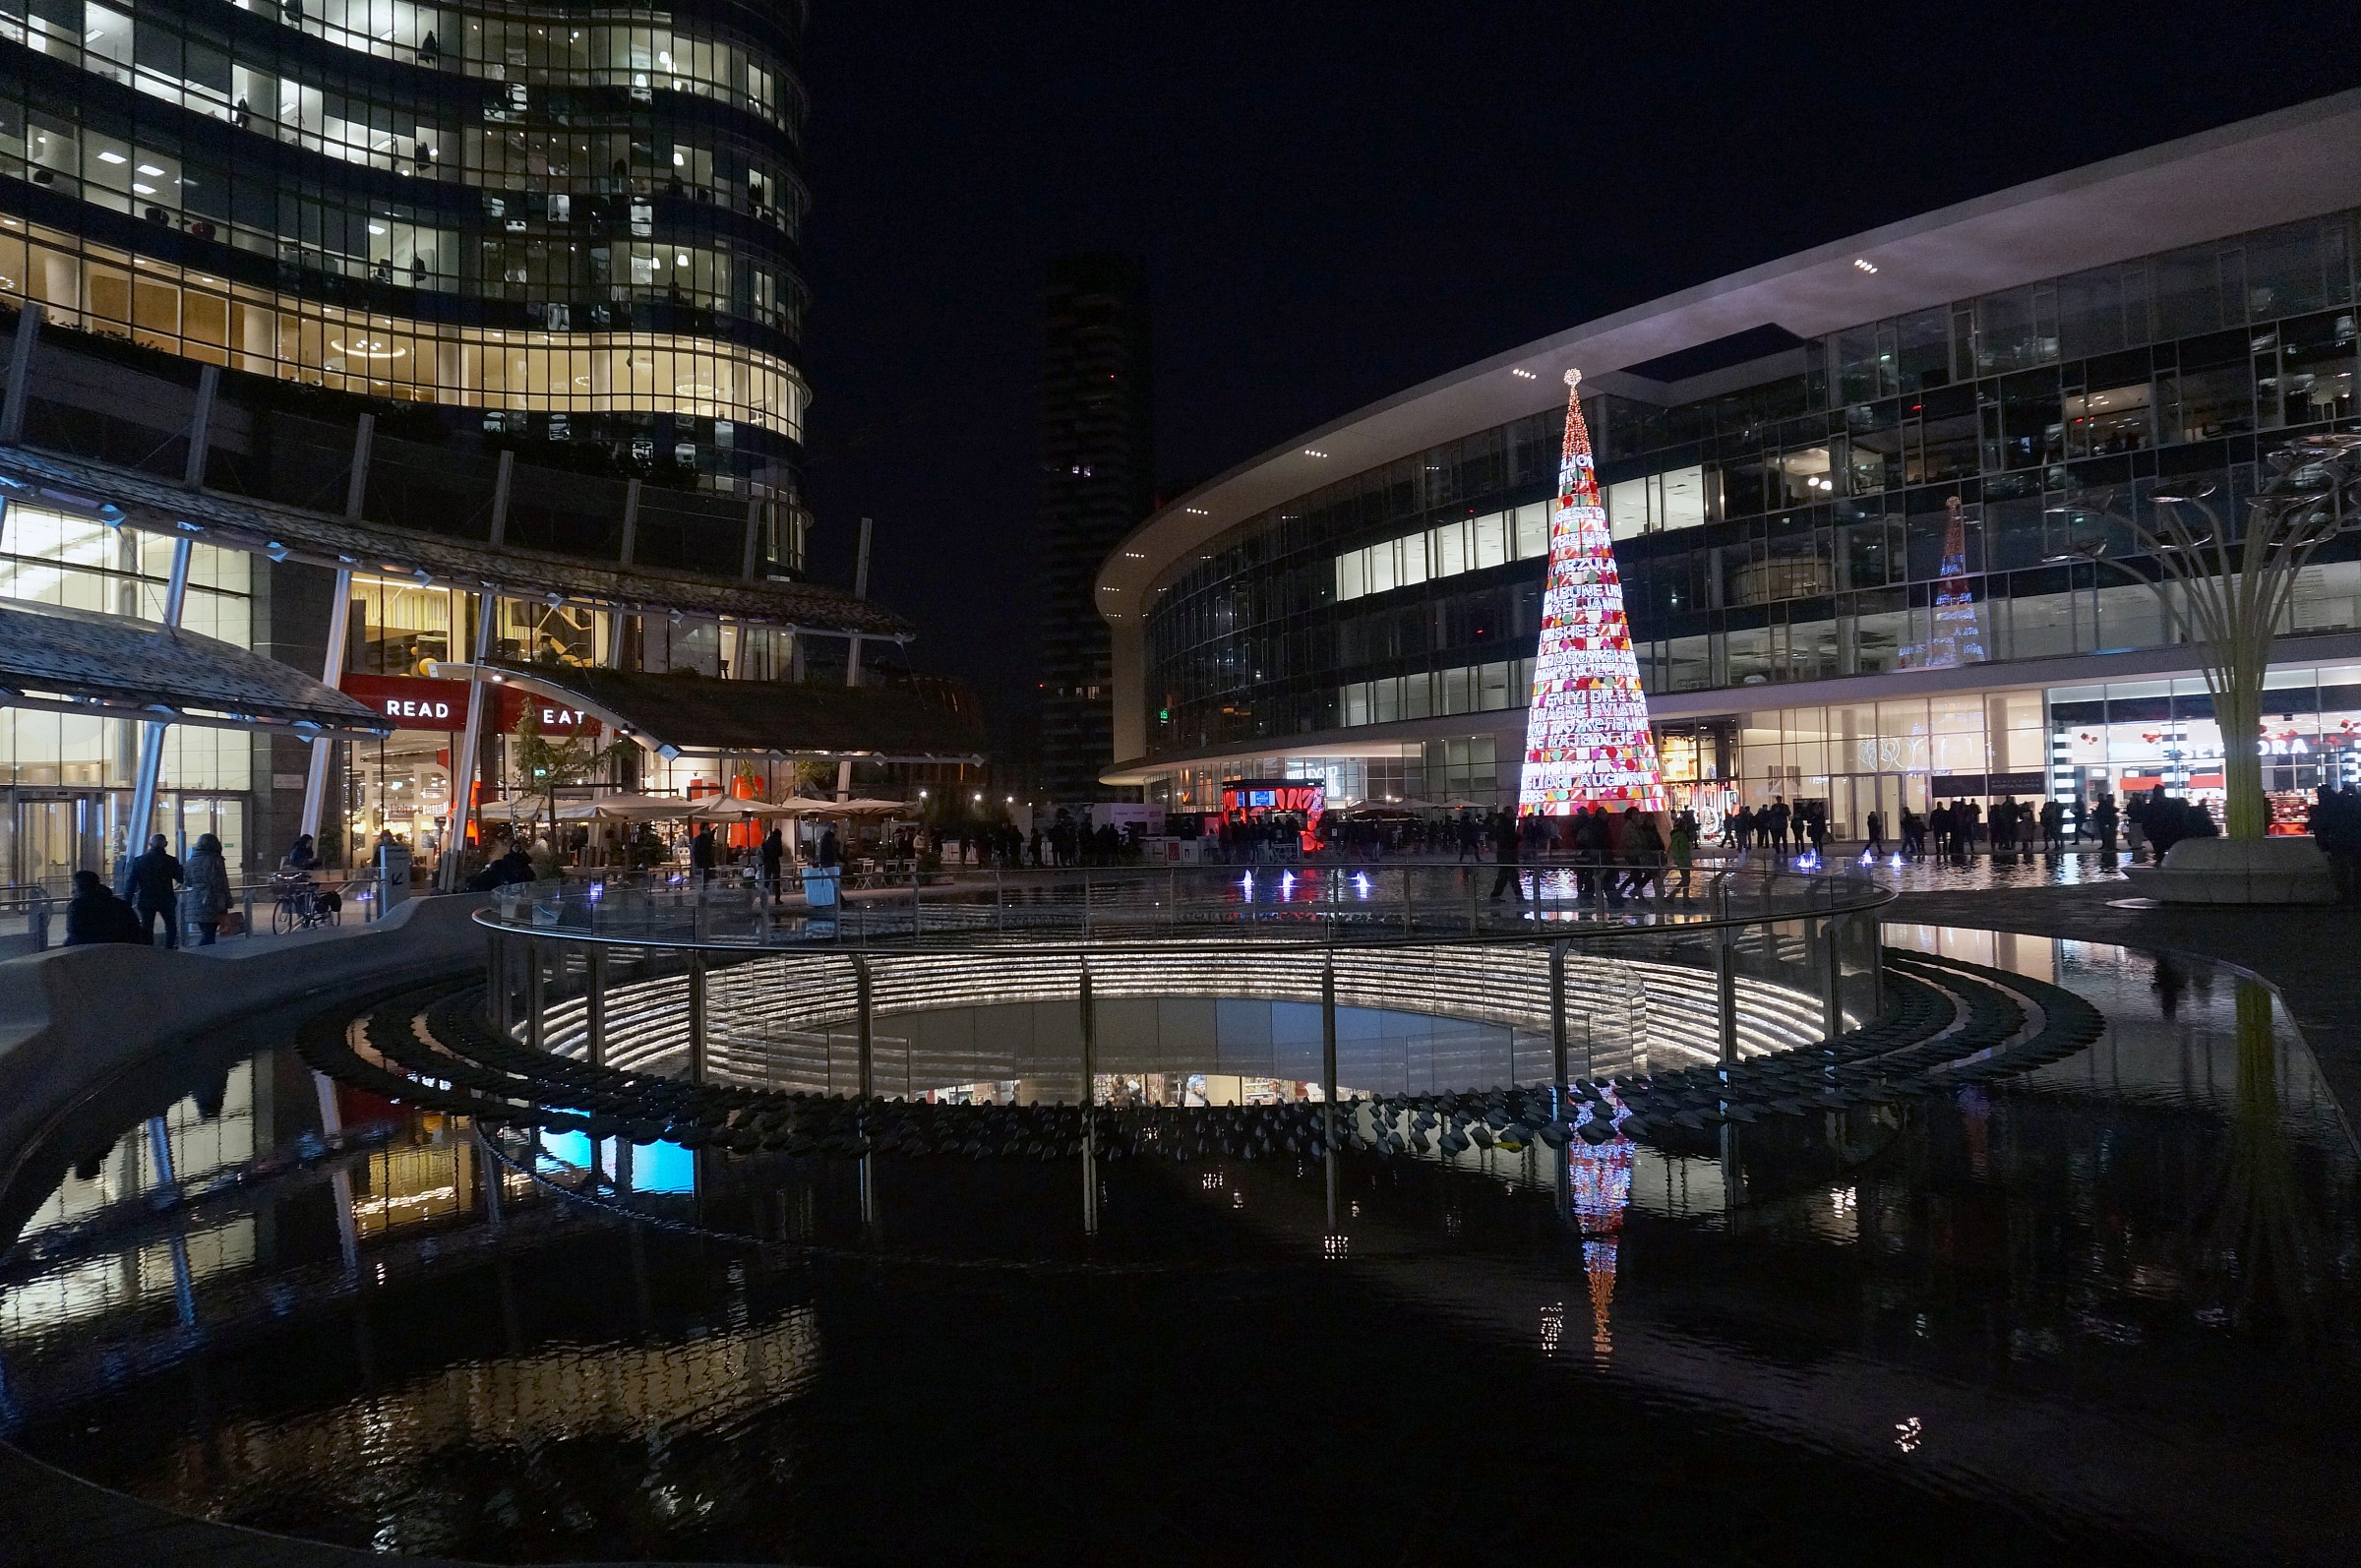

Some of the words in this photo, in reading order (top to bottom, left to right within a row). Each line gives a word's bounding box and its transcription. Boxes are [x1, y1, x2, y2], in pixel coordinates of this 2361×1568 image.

[387, 700, 449, 718] READ
[543, 709, 585, 725] EAT
[1547, 731, 1636, 748] NAJBOLJE
[2182, 738, 2309, 758] SEPORA
[1578, 772, 1644, 788] AUGURI
